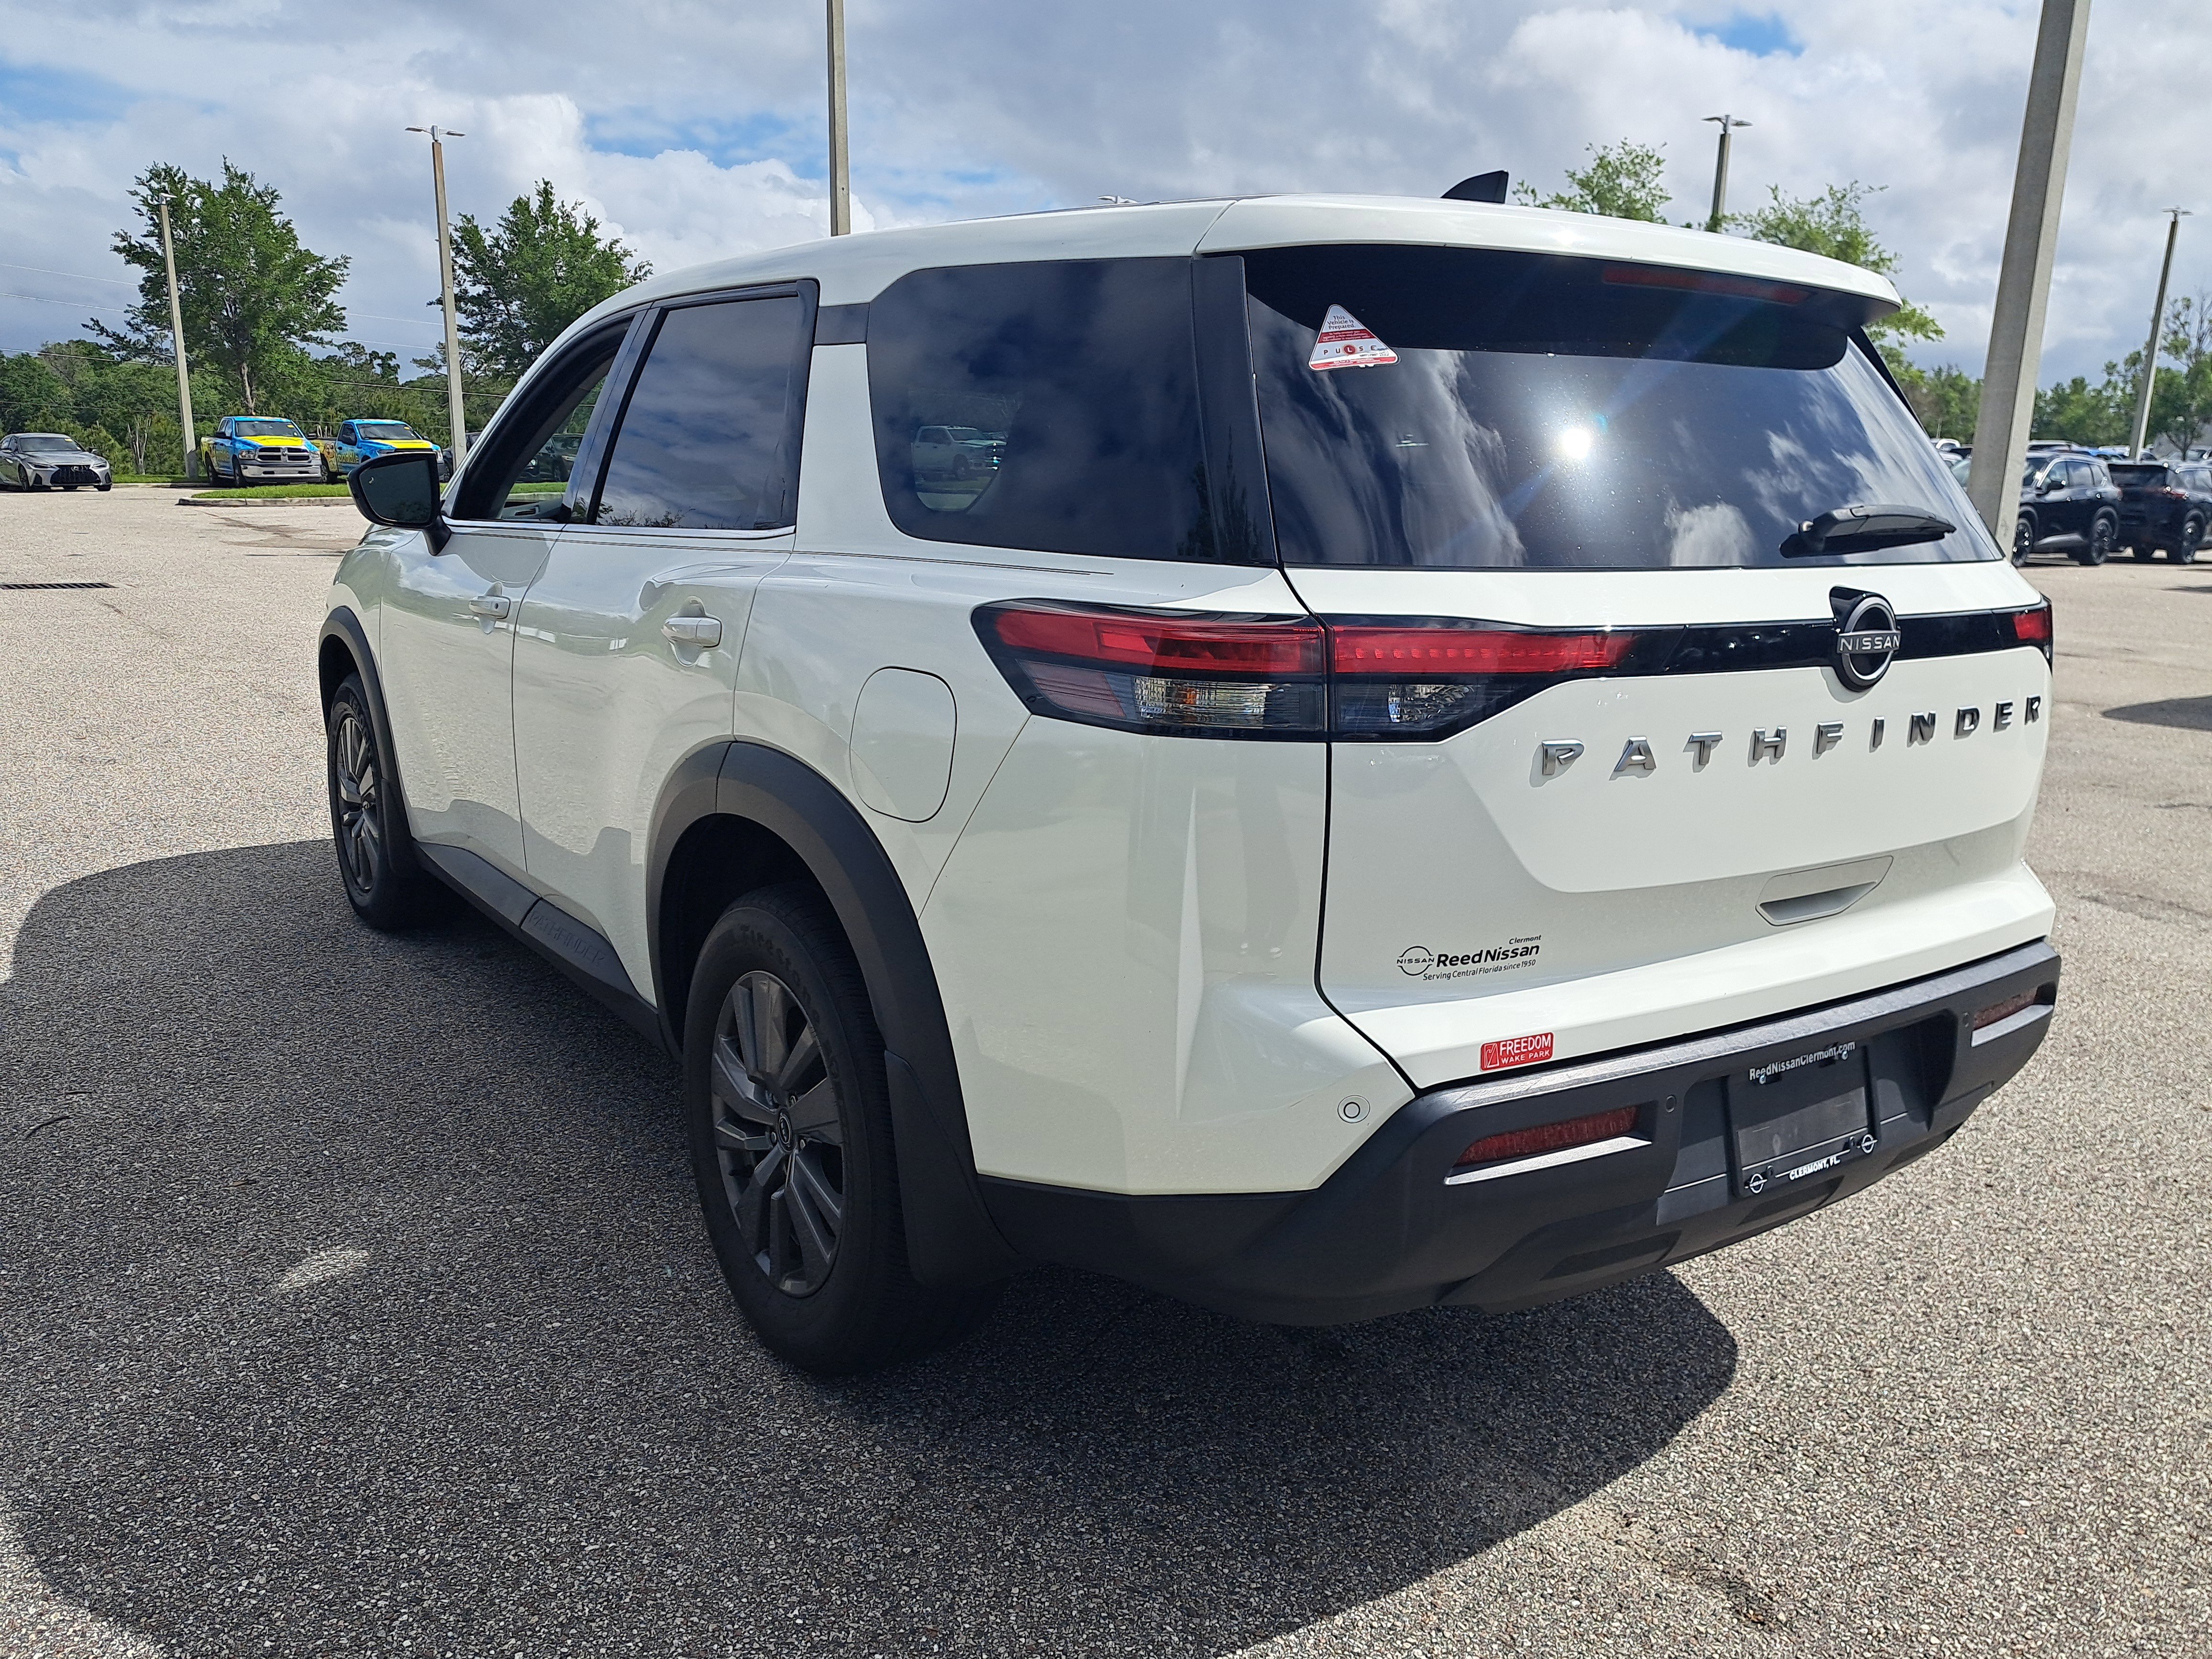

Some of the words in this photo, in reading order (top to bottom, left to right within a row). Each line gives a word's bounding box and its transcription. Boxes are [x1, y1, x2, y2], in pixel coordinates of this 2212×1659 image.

[1839, 635, 1900, 651] NISSAN
[1541, 695, 2042, 775] PATHFINDER
[528, 911, 607, 965] PATHFINDER
[1509, 934, 1542, 945] Clermont
[1423, 972, 1451, 981] Serving
[1452, 968, 1478, 978] Central
[1479, 965, 1502, 975] Florida
[1503, 962, 1520, 971] since
[1521, 959, 1537, 968] 1950
[1499, 1033, 1551, 1056] FREEDOM
[1501, 1054, 1526, 1064] WAKE
[1528, 1049, 1550, 1060] PARK
[1749, 1041, 1856, 1081] ReedNissanClermont.com
[1789, 1159, 1829, 1180] CLERMONT,
[1829, 1156, 1841, 1166] FL
